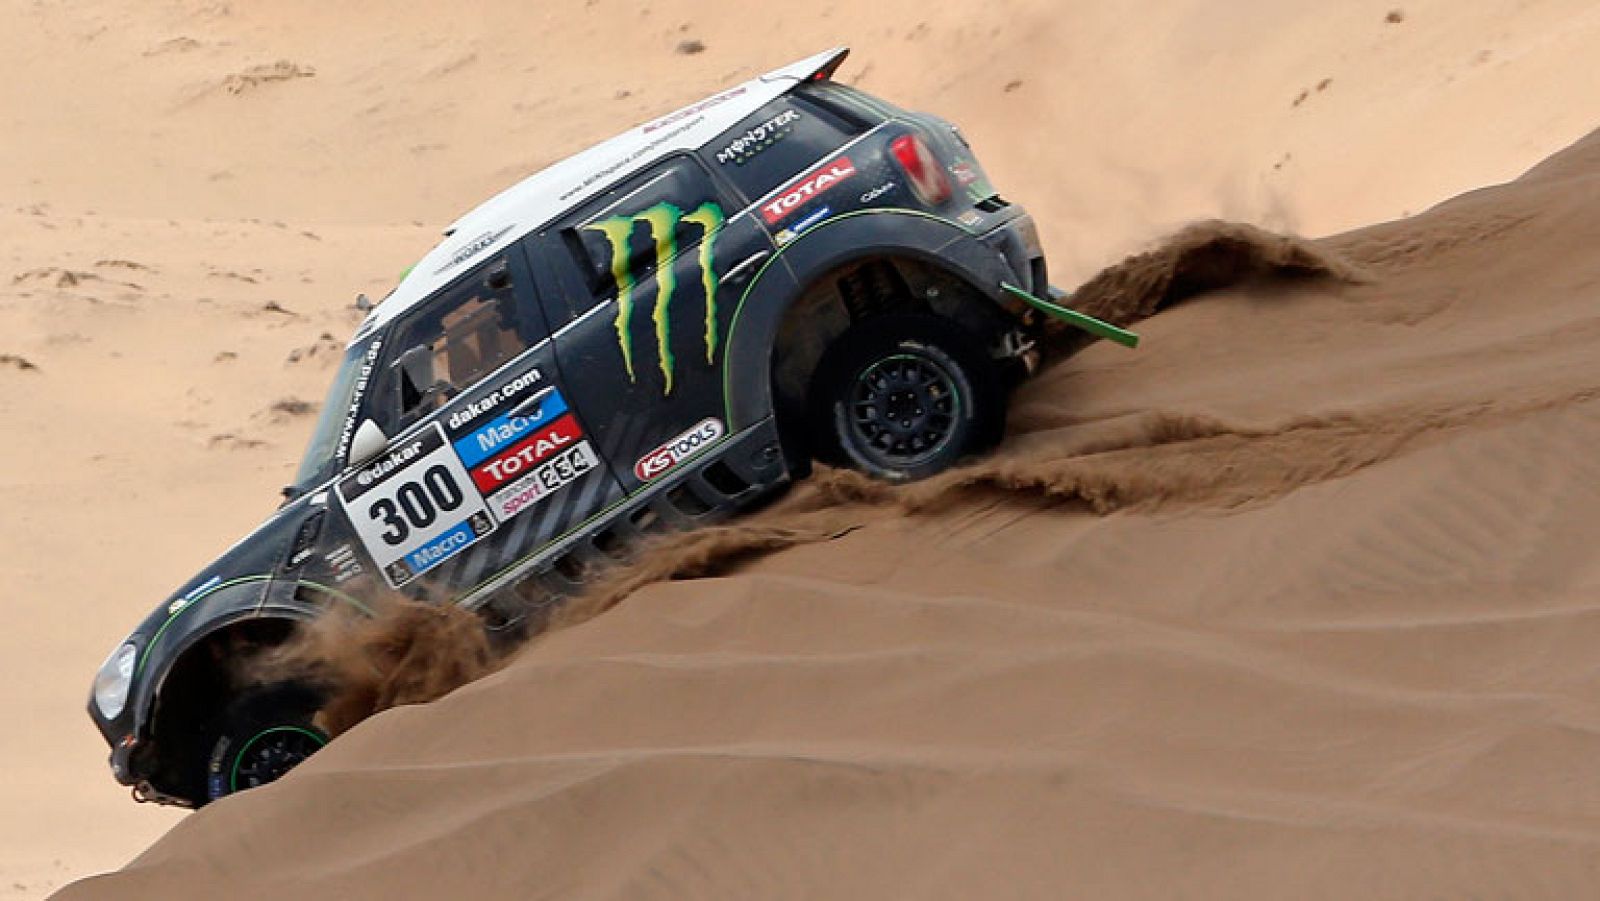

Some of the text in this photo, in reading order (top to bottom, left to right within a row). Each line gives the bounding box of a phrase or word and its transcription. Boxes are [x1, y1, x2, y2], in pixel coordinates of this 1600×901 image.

[764, 166, 855, 214] TOTAL
[450, 369, 541, 429] dakar.com
[482, 432, 572, 481] TOTAL
[368, 464, 463, 545] 300
[503, 483, 542, 514] sport
[413, 531, 468, 568] Macro
